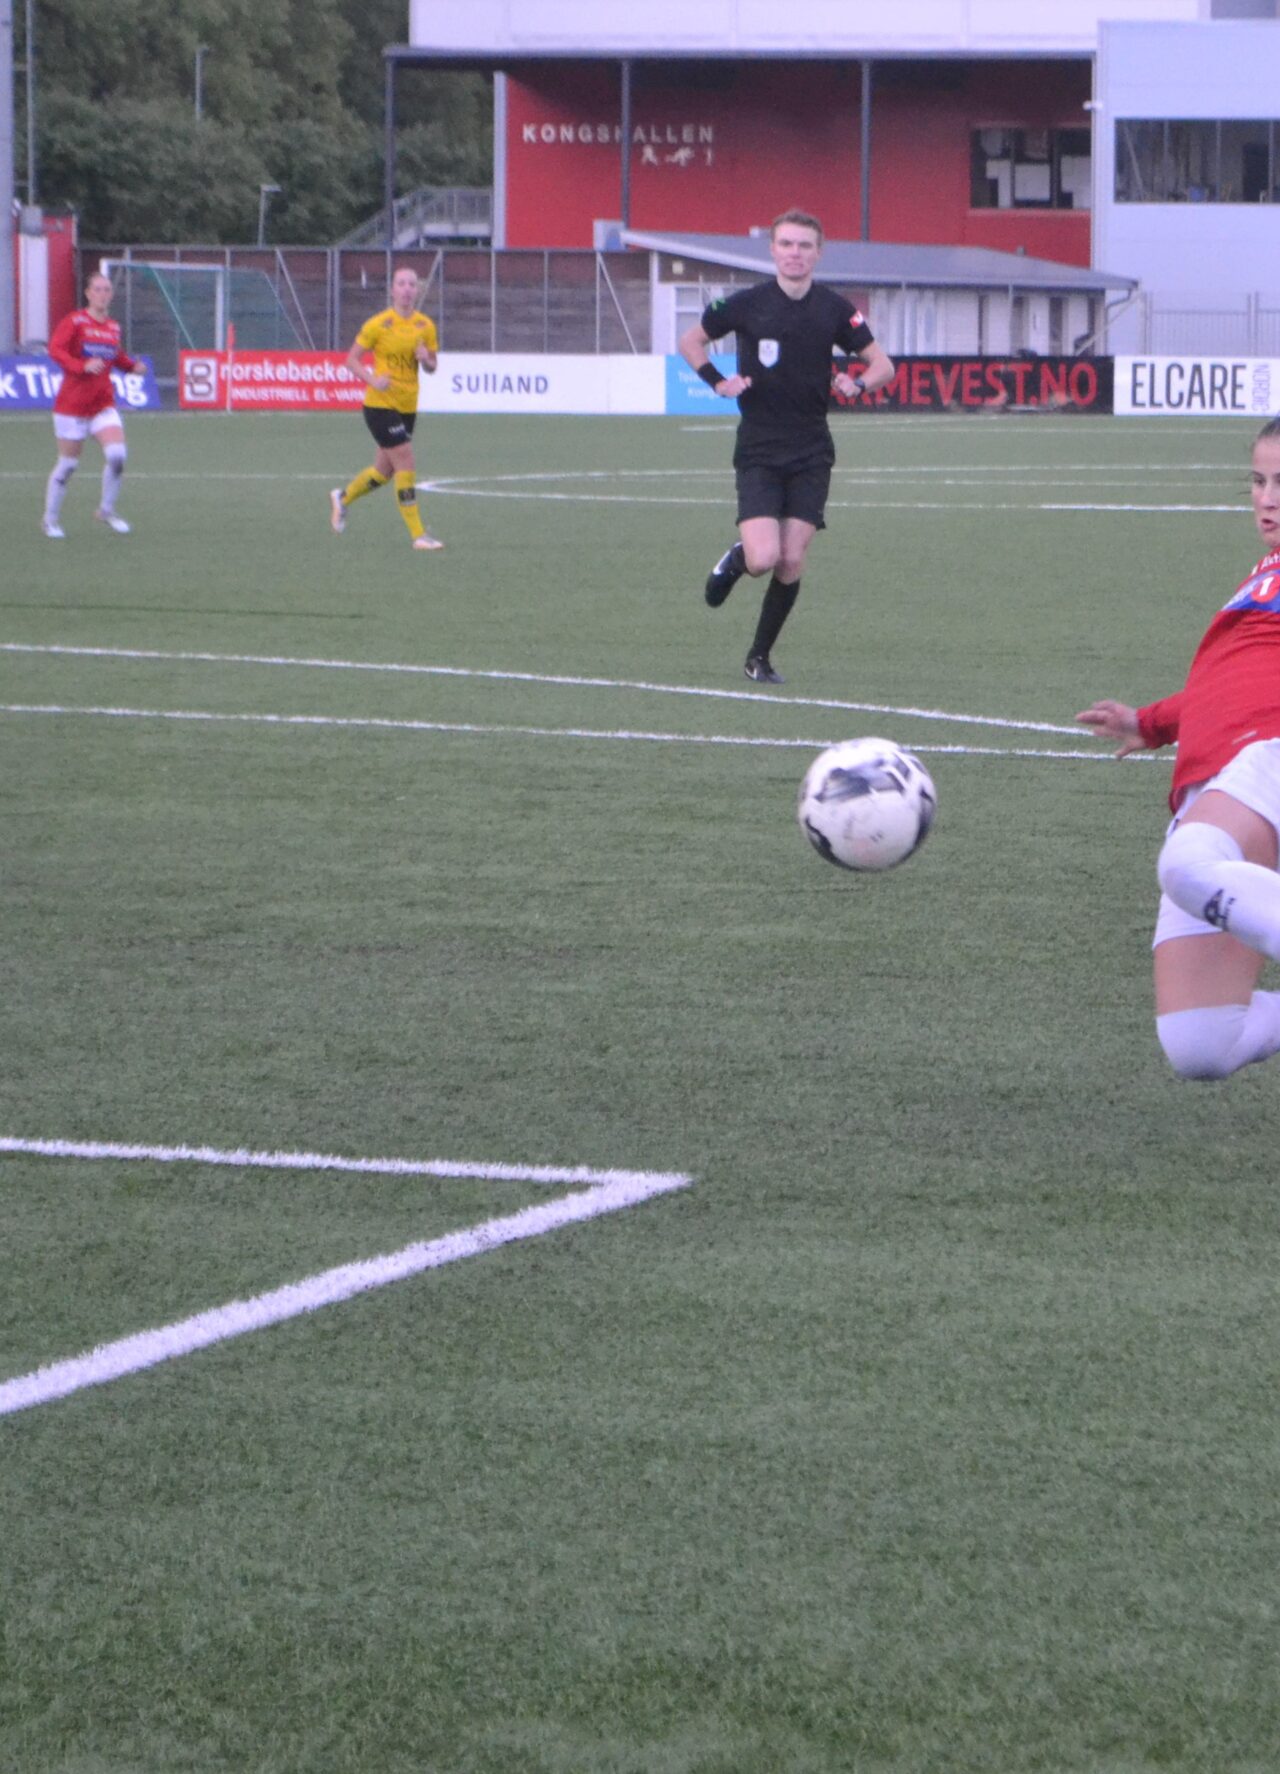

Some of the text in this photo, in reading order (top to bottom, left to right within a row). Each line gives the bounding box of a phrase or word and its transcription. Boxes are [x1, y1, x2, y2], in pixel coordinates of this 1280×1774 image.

[1131, 362, 1247, 410] ELCARE
[1252, 364, 1271, 412] NORDIC
[1258, 576, 1275, 597] 1
